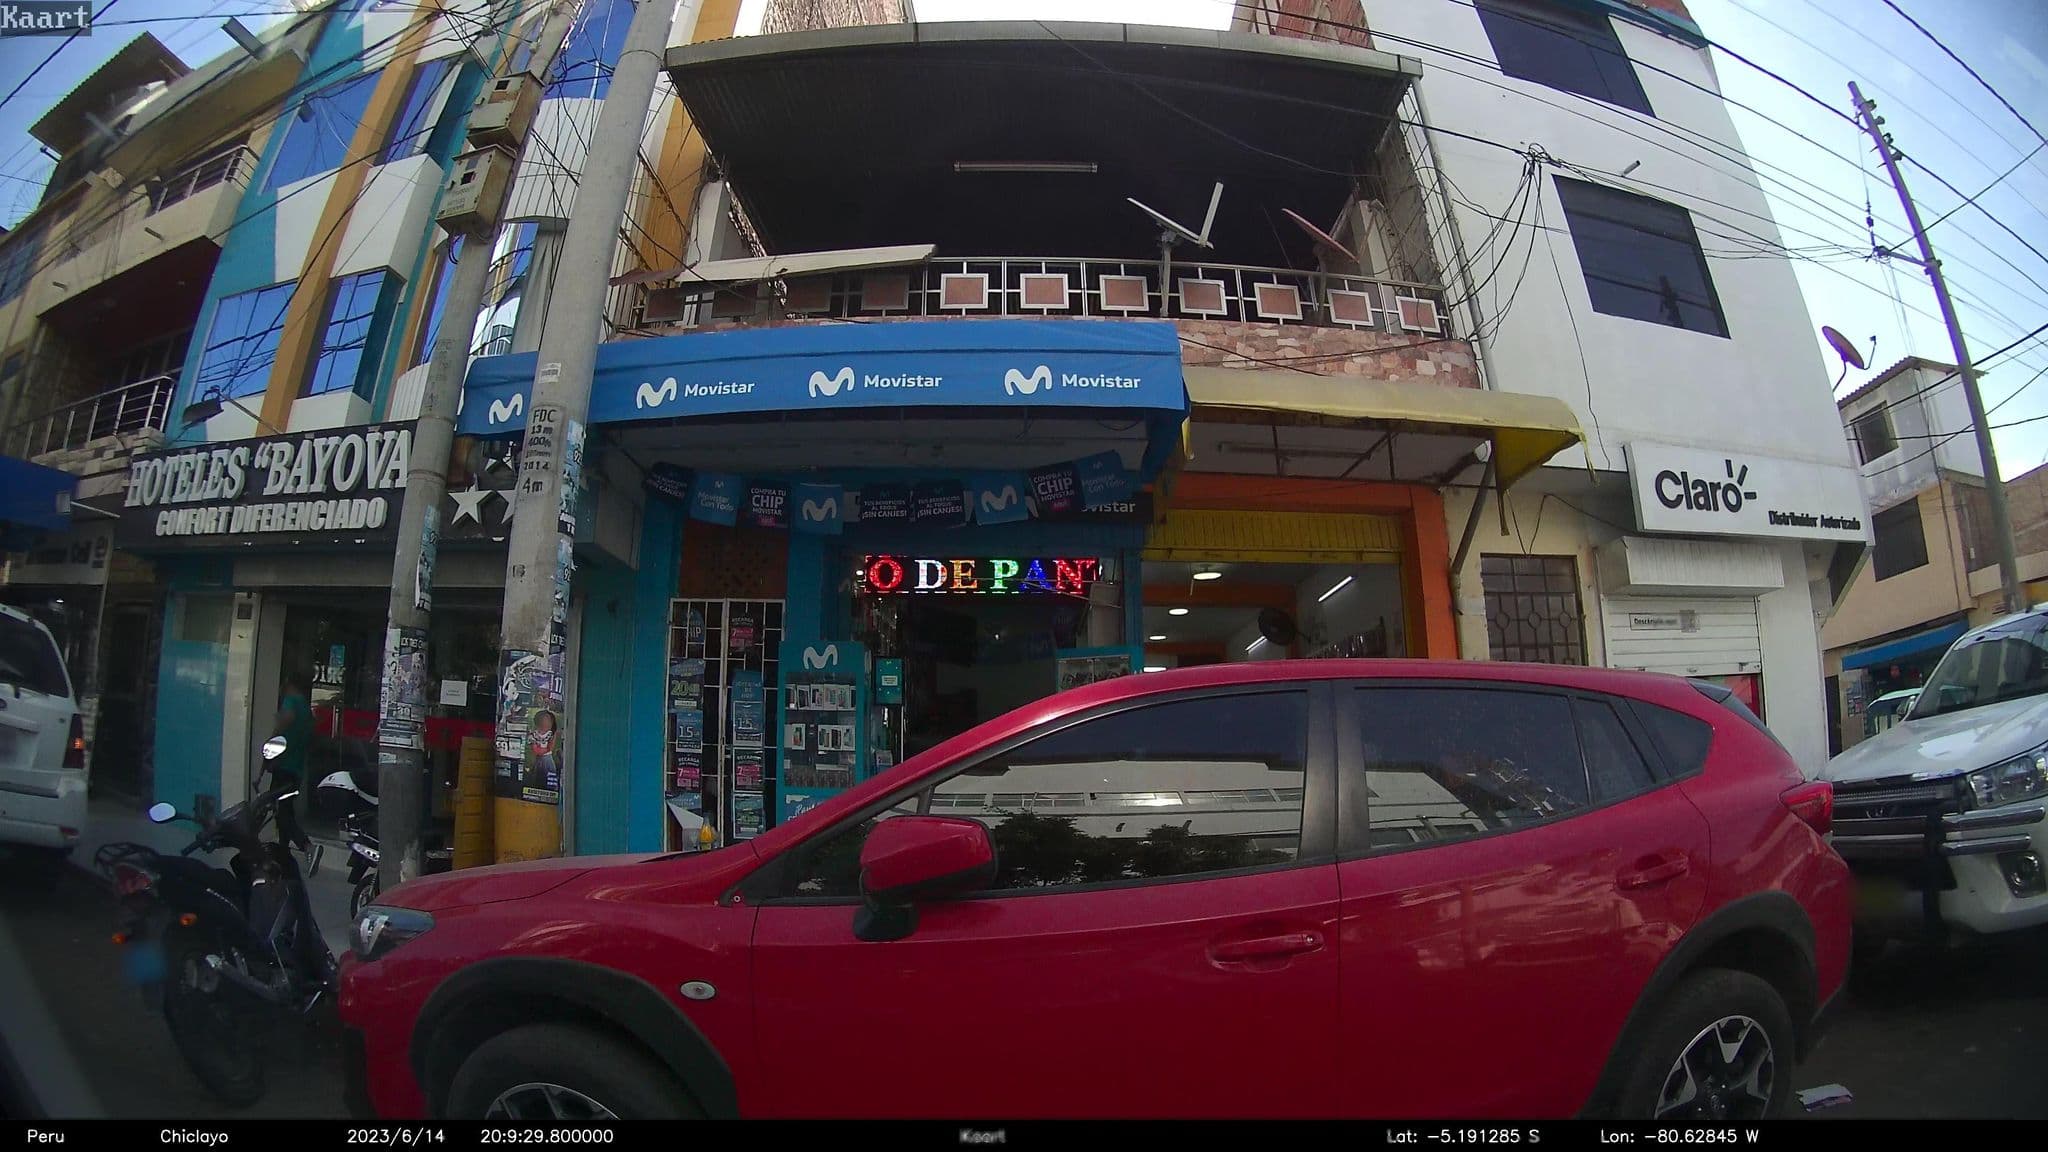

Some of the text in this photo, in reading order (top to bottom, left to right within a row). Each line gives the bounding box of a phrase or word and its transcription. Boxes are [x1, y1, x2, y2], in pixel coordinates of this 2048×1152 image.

[684, 381, 755, 397] Movistar
[864, 374, 942, 389] Movistar
[1062, 374, 1141, 390] Movistar
[533, 409, 557, 423] FDC
[125, 446, 250, 507] HOTELES
[1037, 477, 1073, 495] CHIP
[1655, 468, 1743, 513] Claro
[752, 495, 784, 509] CHIP
[156, 497, 388, 536] CONFORT DIFERENCIADO
[752, 508, 783, 516] MOVISTAR
[868, 558, 903, 589] O
[914, 559, 978, 589] DE
[679, 726, 694, 737] 15
